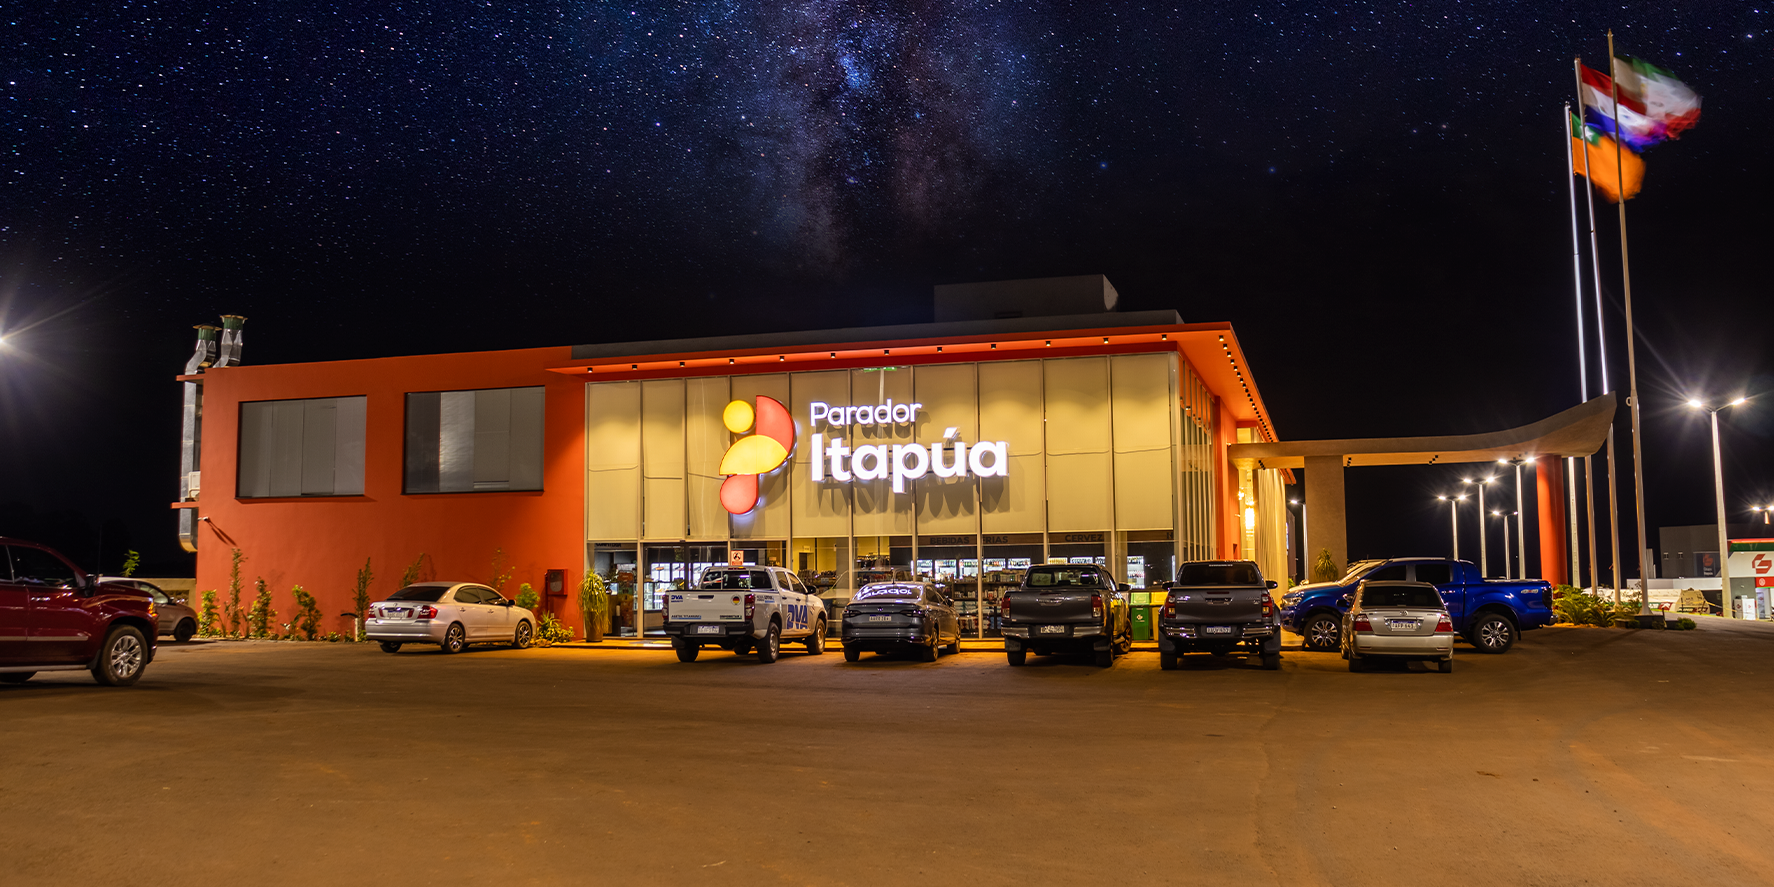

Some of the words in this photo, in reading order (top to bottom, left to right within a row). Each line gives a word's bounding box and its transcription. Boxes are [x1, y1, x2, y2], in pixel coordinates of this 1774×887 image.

[810, 398, 922, 427] Parador
[811, 427, 1009, 494] Itapúa
[930, 536, 970, 545] BEBIDAS
[787, 604, 808, 630] DVA
